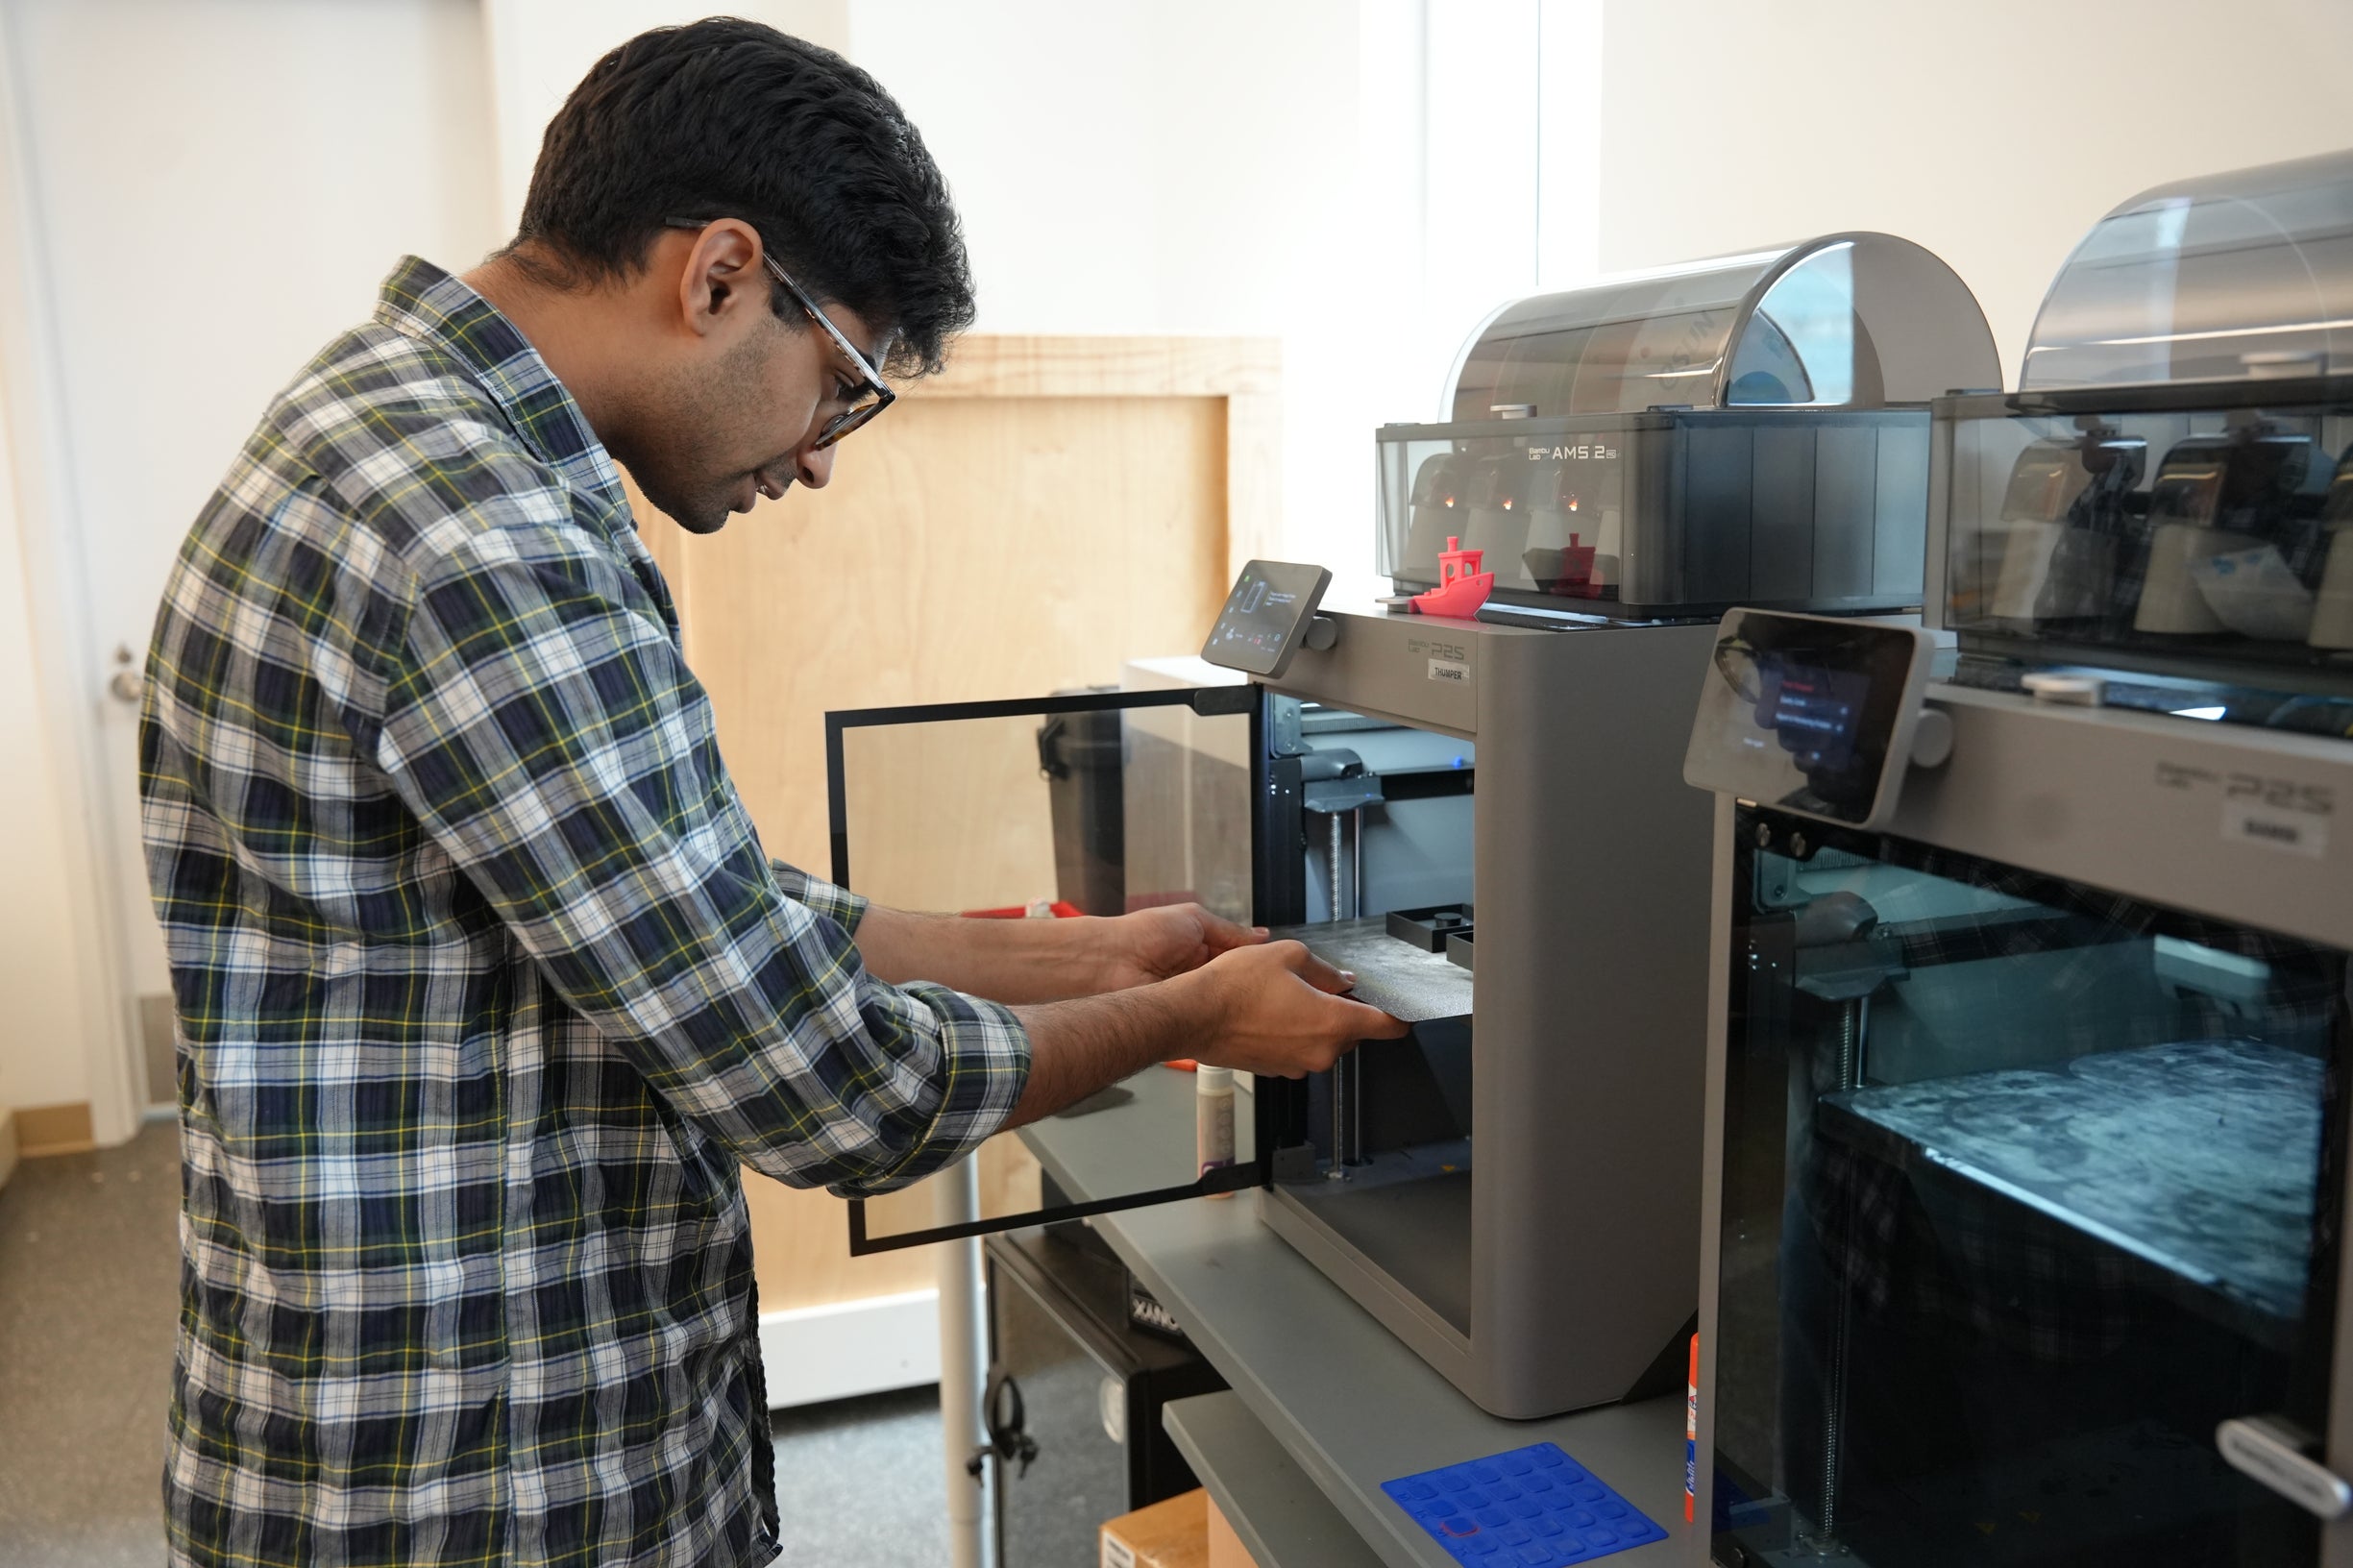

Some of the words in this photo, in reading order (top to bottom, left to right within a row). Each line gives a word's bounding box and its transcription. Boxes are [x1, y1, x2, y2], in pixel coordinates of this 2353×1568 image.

[1552, 446, 1589, 460] AMS
[1594, 445, 1605, 459] 2
[1434, 667, 1462, 680] THUMPER
